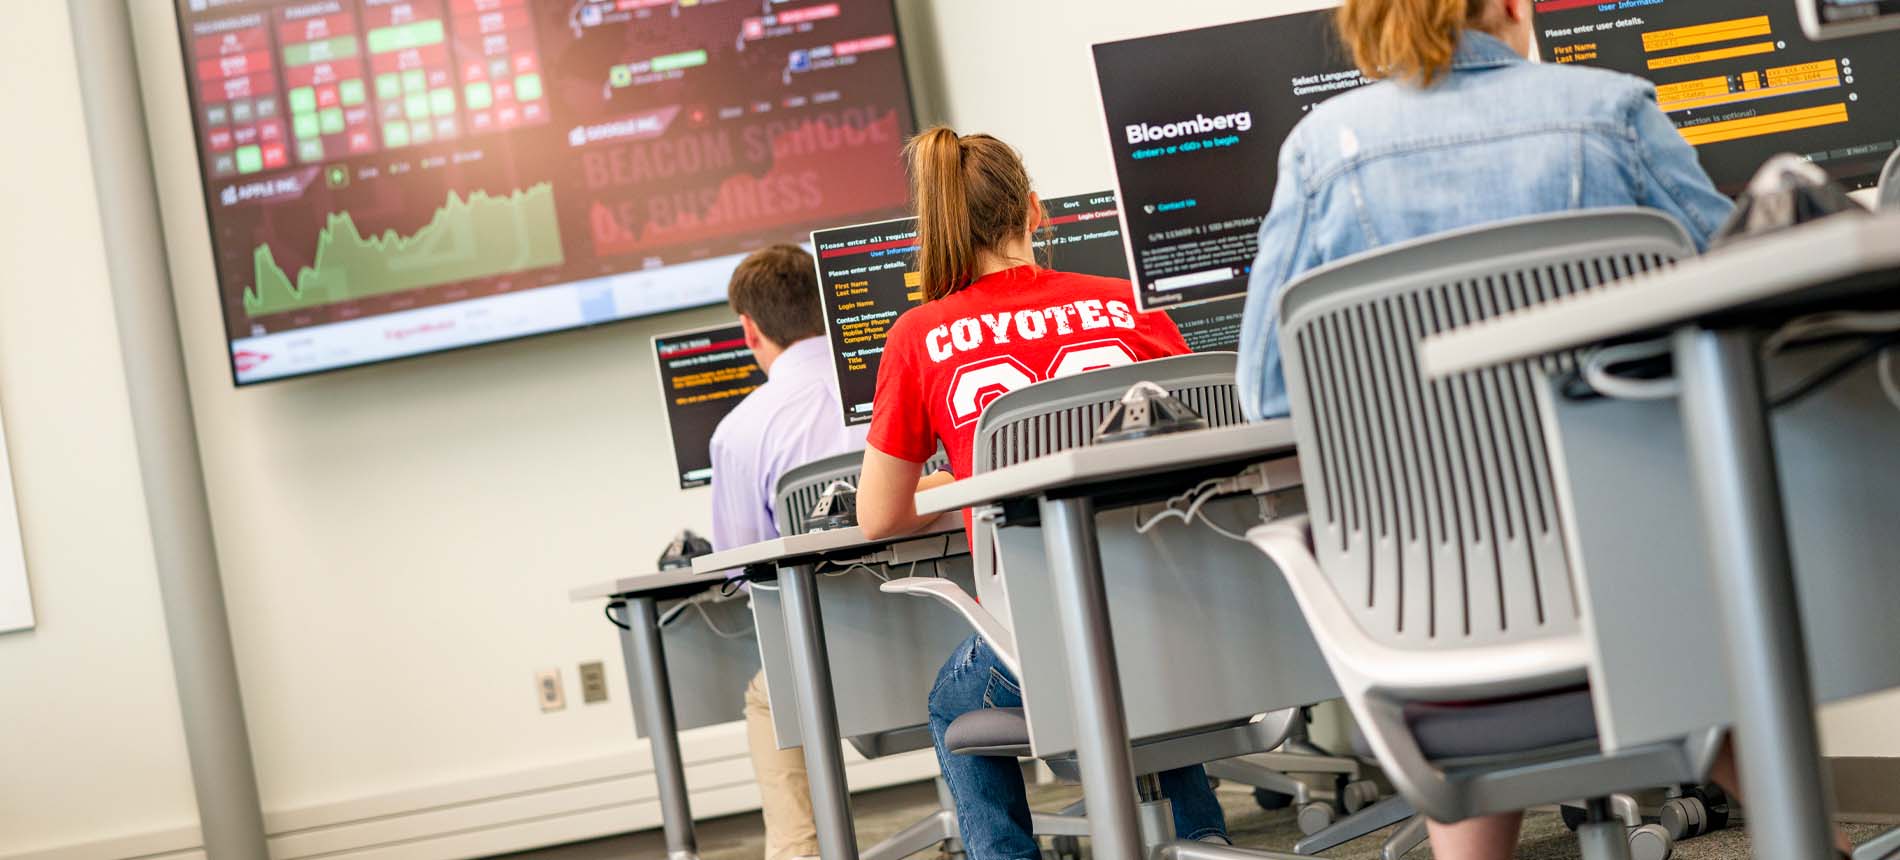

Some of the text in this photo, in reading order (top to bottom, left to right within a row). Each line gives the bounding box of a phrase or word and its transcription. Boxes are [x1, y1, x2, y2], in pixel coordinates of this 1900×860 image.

[1598, 4, 1616, 12] User
[1545, 16, 1645, 38] Please enter user details.
[1554, 43, 1597, 55] First Name
[1556, 52, 1597, 63] Last Name
[1292, 69, 1360, 87] Select Language
[1293, 79, 1359, 96] Communication
[1125, 111, 1252, 145] Bloomberg
[582, 107, 889, 190] BEACOM SCHOOL
[1166, 145, 1177, 154] or
[1202, 139, 1213, 148] to
[1213, 135, 1240, 147] begin
[1158, 200, 1185, 212] Contact
[820, 242, 844, 251] Please
[847, 239, 867, 247] enter
[886, 231, 917, 242] required
[1052, 237, 1059, 245] of
[1083, 230, 1119, 240] Information
[884, 260, 907, 270] details.
[838, 303, 855, 311] Login
[836, 310, 897, 324] Contact Information
[842, 322, 869, 331] Company
[925, 299, 1136, 363] COYOTES
[844, 335, 871, 344] Company
